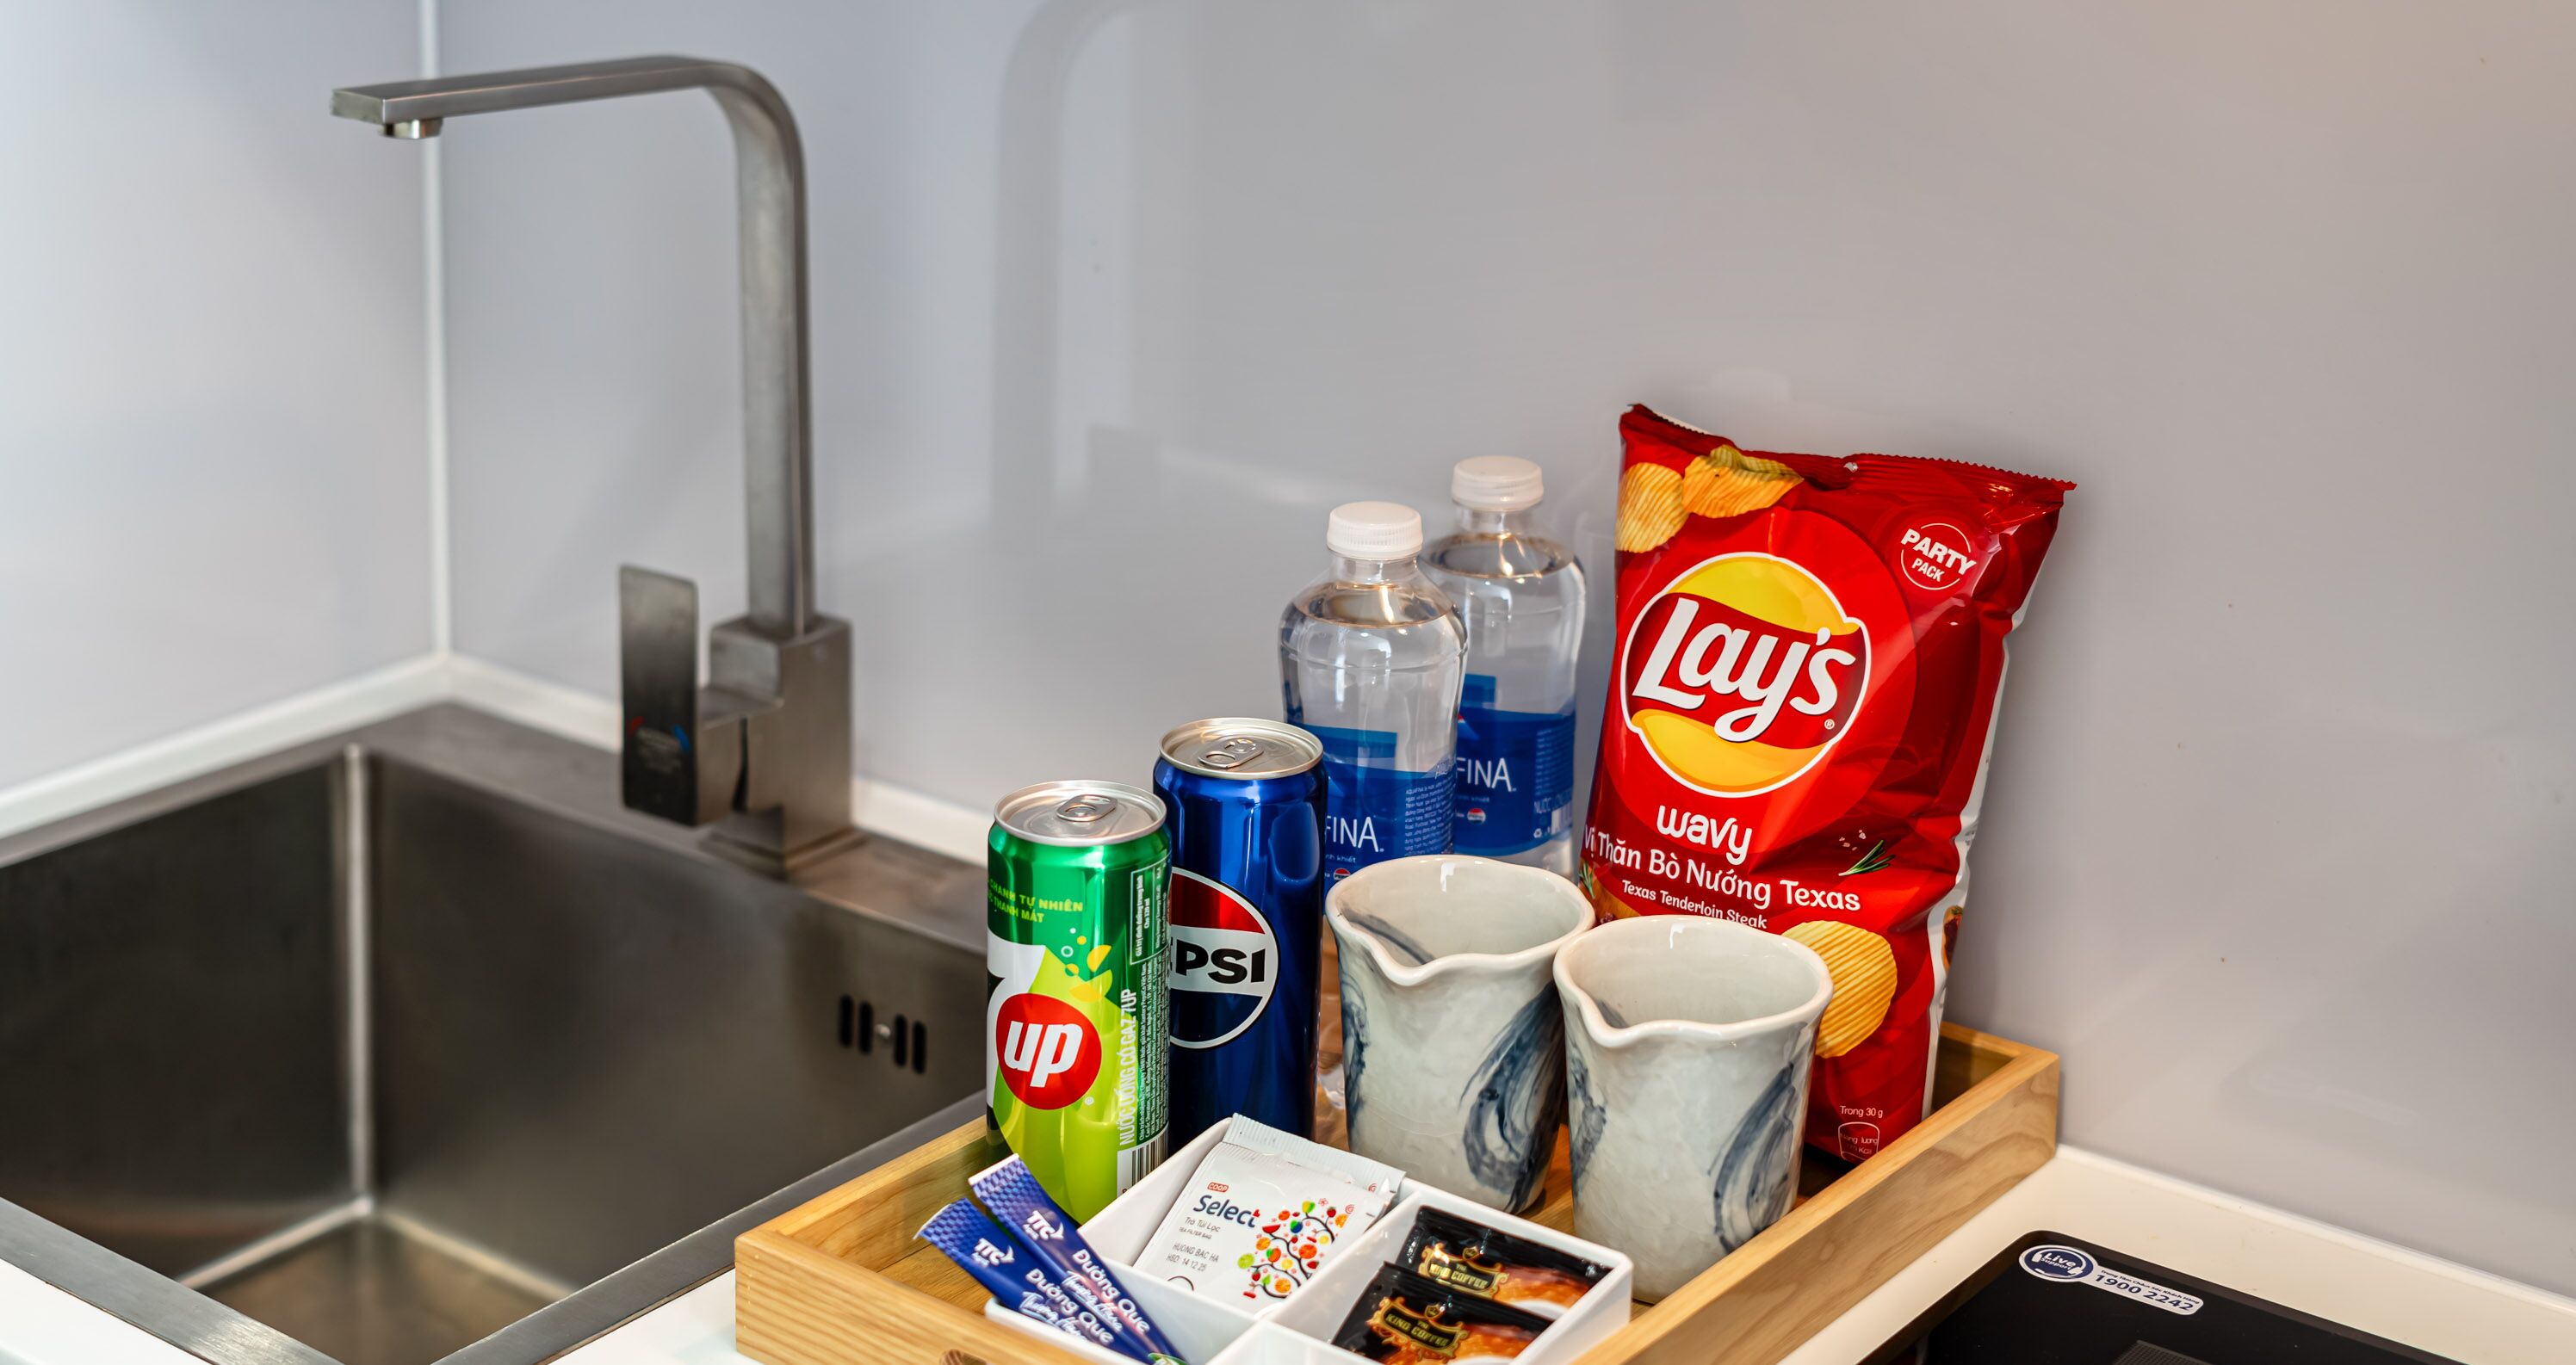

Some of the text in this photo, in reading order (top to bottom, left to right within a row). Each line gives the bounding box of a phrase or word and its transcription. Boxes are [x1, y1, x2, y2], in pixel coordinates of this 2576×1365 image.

[1901, 528, 1976, 576] PARTY
[1912, 558, 1946, 583] PACK
[1632, 596, 1856, 743] Lay's
[1656, 806, 1753, 866] wavy
[1584, 825, 1861, 911] Vị Thăn Bò Nướng Texas
[1622, 880, 1768, 930] Texas Tenderloin Steak
[1172, 937, 1266, 985] PSI
[1003, 1021, 1084, 1089] up
[1114, 988, 1137, 1146] NƯỚC UỐNG CÓ GAZ 7UP
[1839, 1105, 1884, 1119] Trong 30 g
[1192, 1194, 1260, 1228] Select
[1208, 1183, 1228, 1192] COOP
[2040, 1257, 2072, 1271] Support
[2043, 1252, 2077, 1268] Live
[1025, 1268, 1115, 1344] Đường Que
[1072, 1249, 1150, 1334] Đường Que
[2095, 1274, 2194, 1311] 1900 2242
[1385, 1312, 1413, 1332] KING
